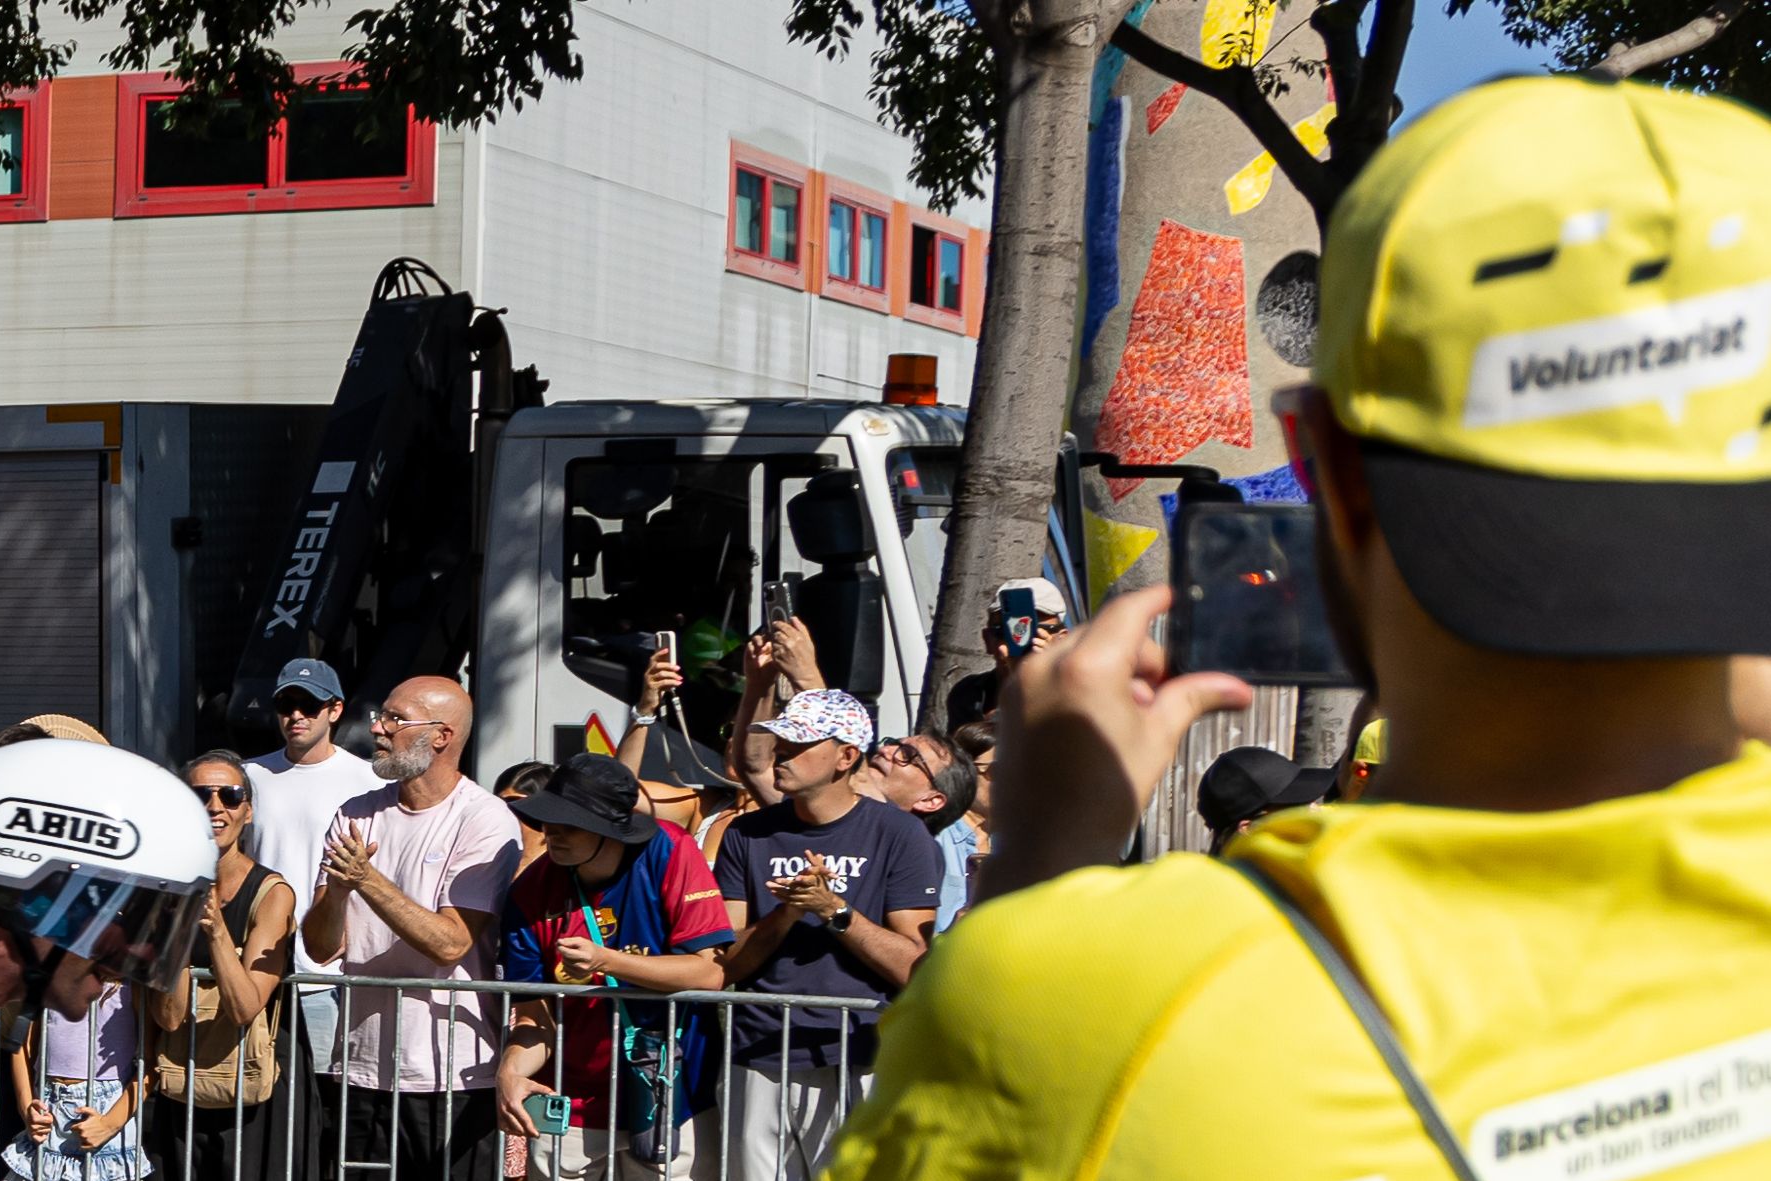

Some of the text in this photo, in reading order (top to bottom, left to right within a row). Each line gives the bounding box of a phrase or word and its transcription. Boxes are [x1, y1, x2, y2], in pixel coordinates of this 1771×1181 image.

[1508, 316, 1746, 393] Voluntariat
[266, 501, 340, 629] TEREX
[5, 806, 121, 850] ABUS
[1494, 1089, 1674, 1160] Barcelona
[1698, 1068, 1723, 1102] el
[1566, 1108, 1741, 1176] un bon tandem
